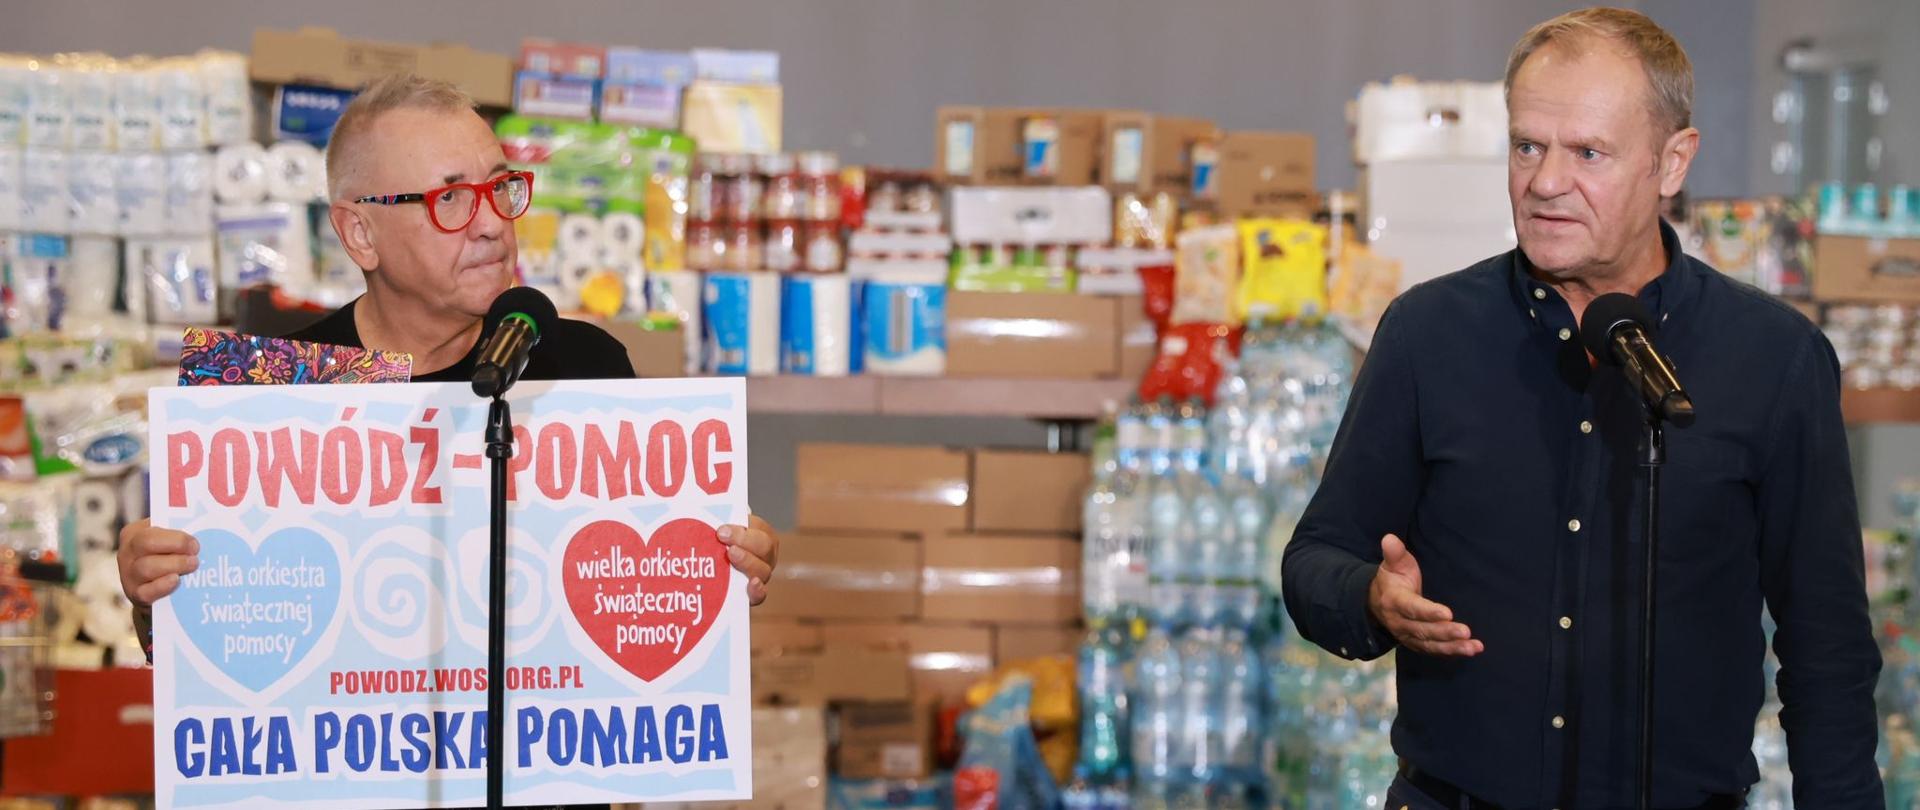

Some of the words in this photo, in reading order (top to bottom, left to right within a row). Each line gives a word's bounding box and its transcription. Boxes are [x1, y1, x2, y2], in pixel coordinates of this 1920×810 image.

[167, 407, 443, 508] POWÓDŹ
[506, 418, 733, 501] POMOC
[184, 555, 243, 589] wielka
[248, 556, 326, 589] orkiestra
[576, 545, 636, 580] wielka
[640, 547, 716, 579] orkiestra
[201, 592, 313, 636] świątecznej
[593, 583, 703, 626] świątecznej
[224, 633, 297, 664] pomocy
[616, 623, 687, 655] pomocy
[174, 715, 298, 778] CAŁA
[314, 711, 488, 773] POLSKA
[517, 704, 729, 768] POMAGA
